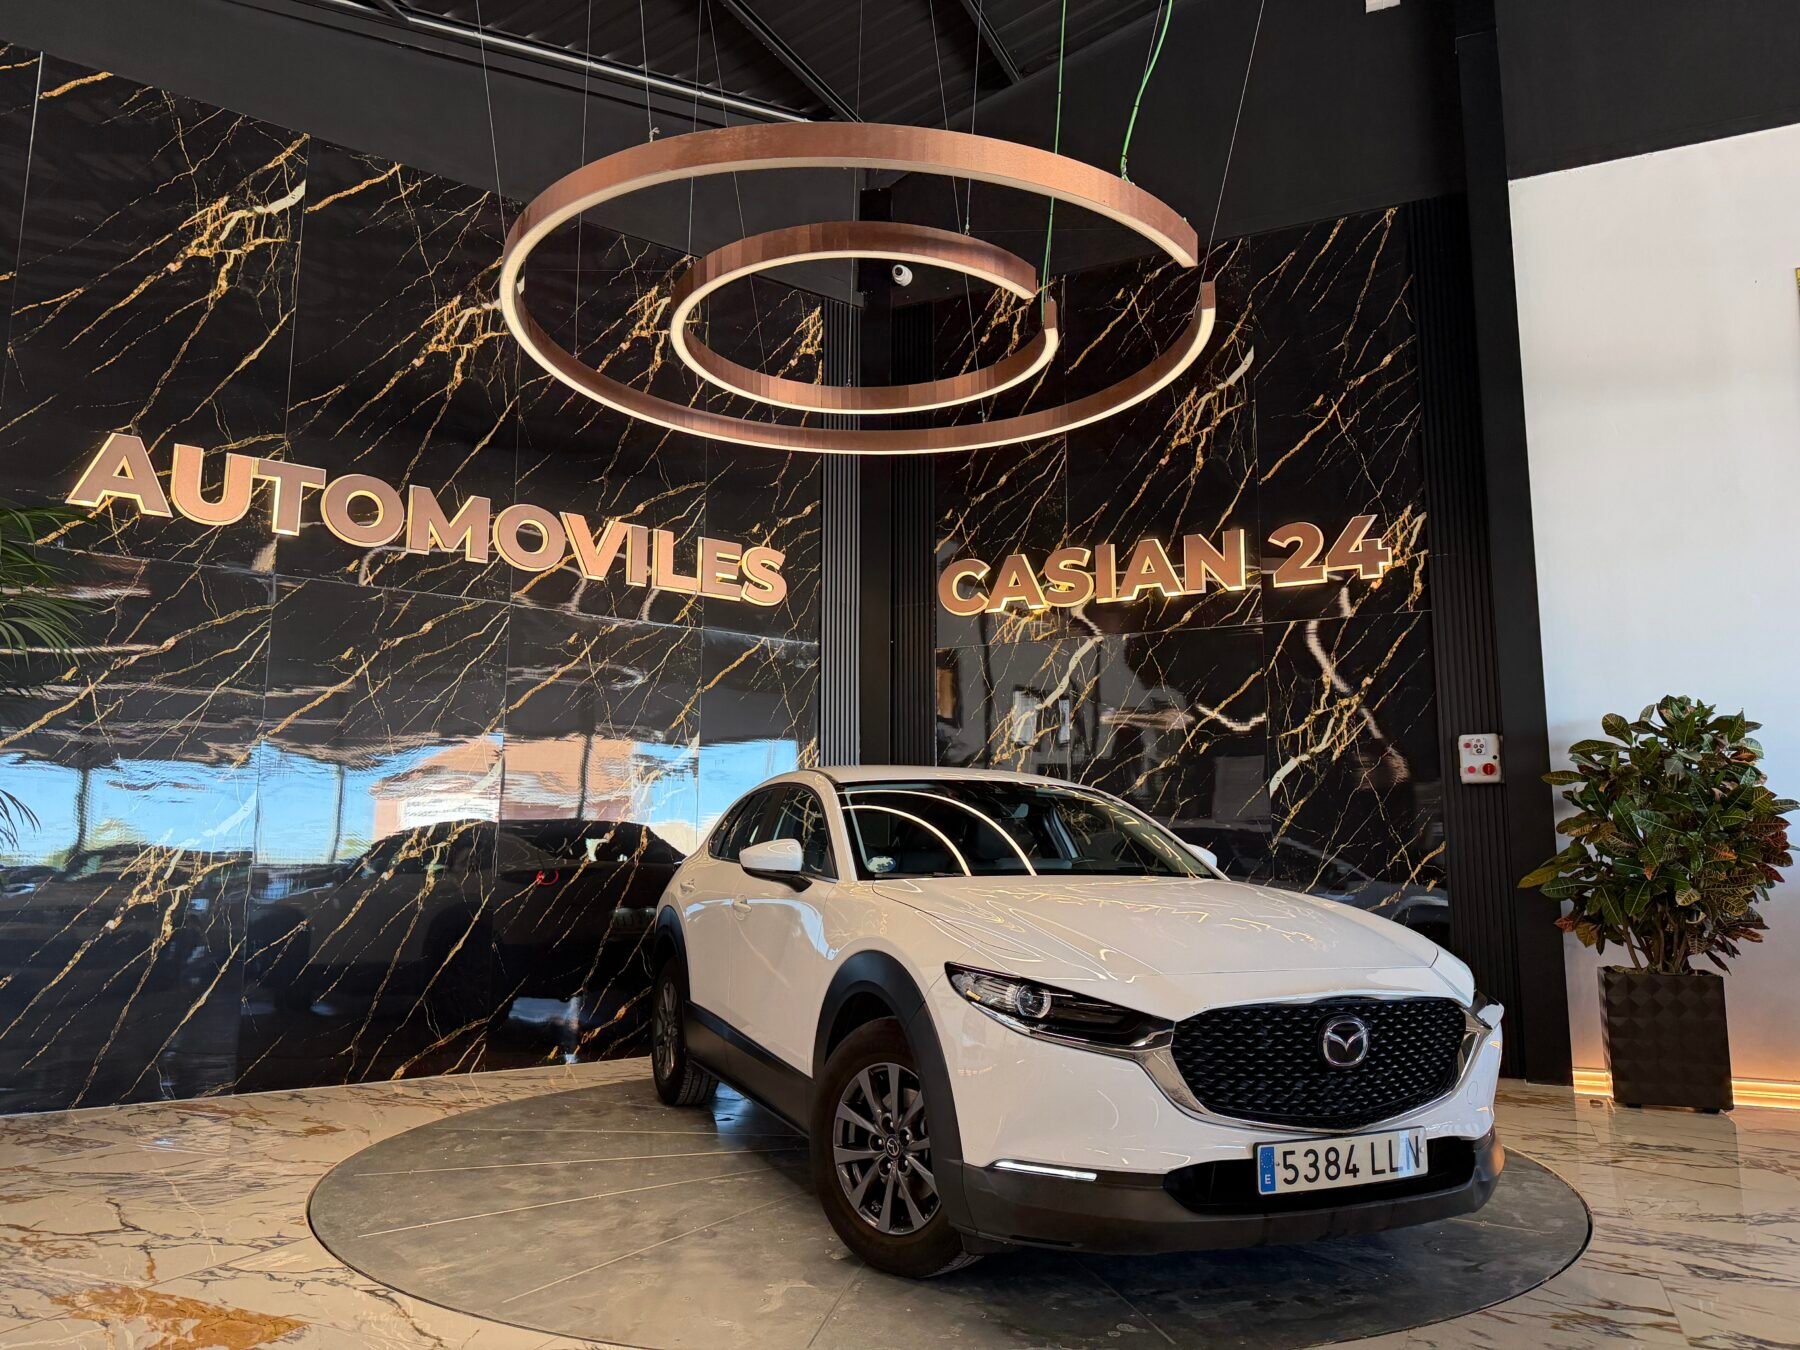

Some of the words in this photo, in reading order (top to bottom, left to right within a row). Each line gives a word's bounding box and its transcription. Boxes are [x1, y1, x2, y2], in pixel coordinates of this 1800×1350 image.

[65, 432, 788, 607] AUTOMOVILES
[937, 528, 1247, 617] CASIAN
[1267, 513, 1393, 588] 24
[1264, 1174, 1272, 1185] E
[1282, 1144, 1360, 1185] 5384
[1370, 1135, 1420, 1176] LLN
